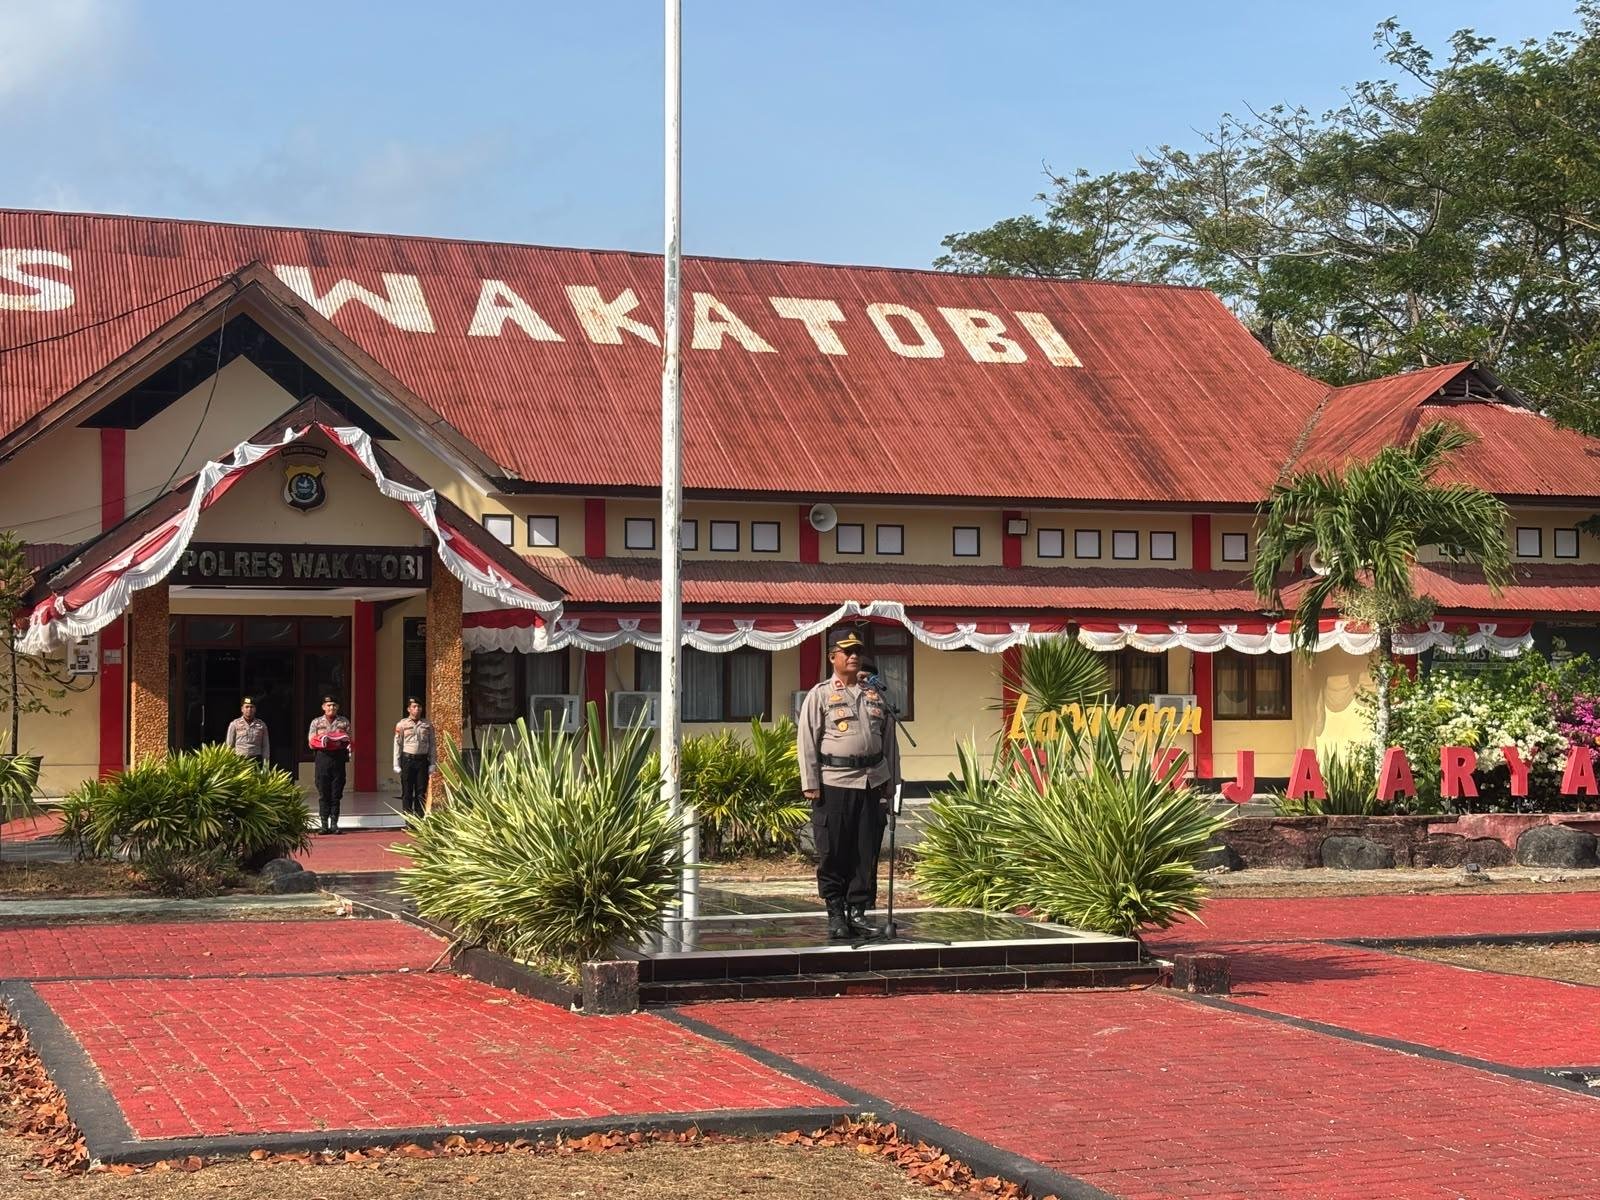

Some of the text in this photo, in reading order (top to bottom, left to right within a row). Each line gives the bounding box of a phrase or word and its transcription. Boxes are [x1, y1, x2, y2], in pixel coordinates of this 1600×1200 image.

[273, 264, 1083, 368] WAKATOBI
[182, 551, 424, 580] POLRES WAKATOBI
[1377, 745, 1599, 800] ARYA
